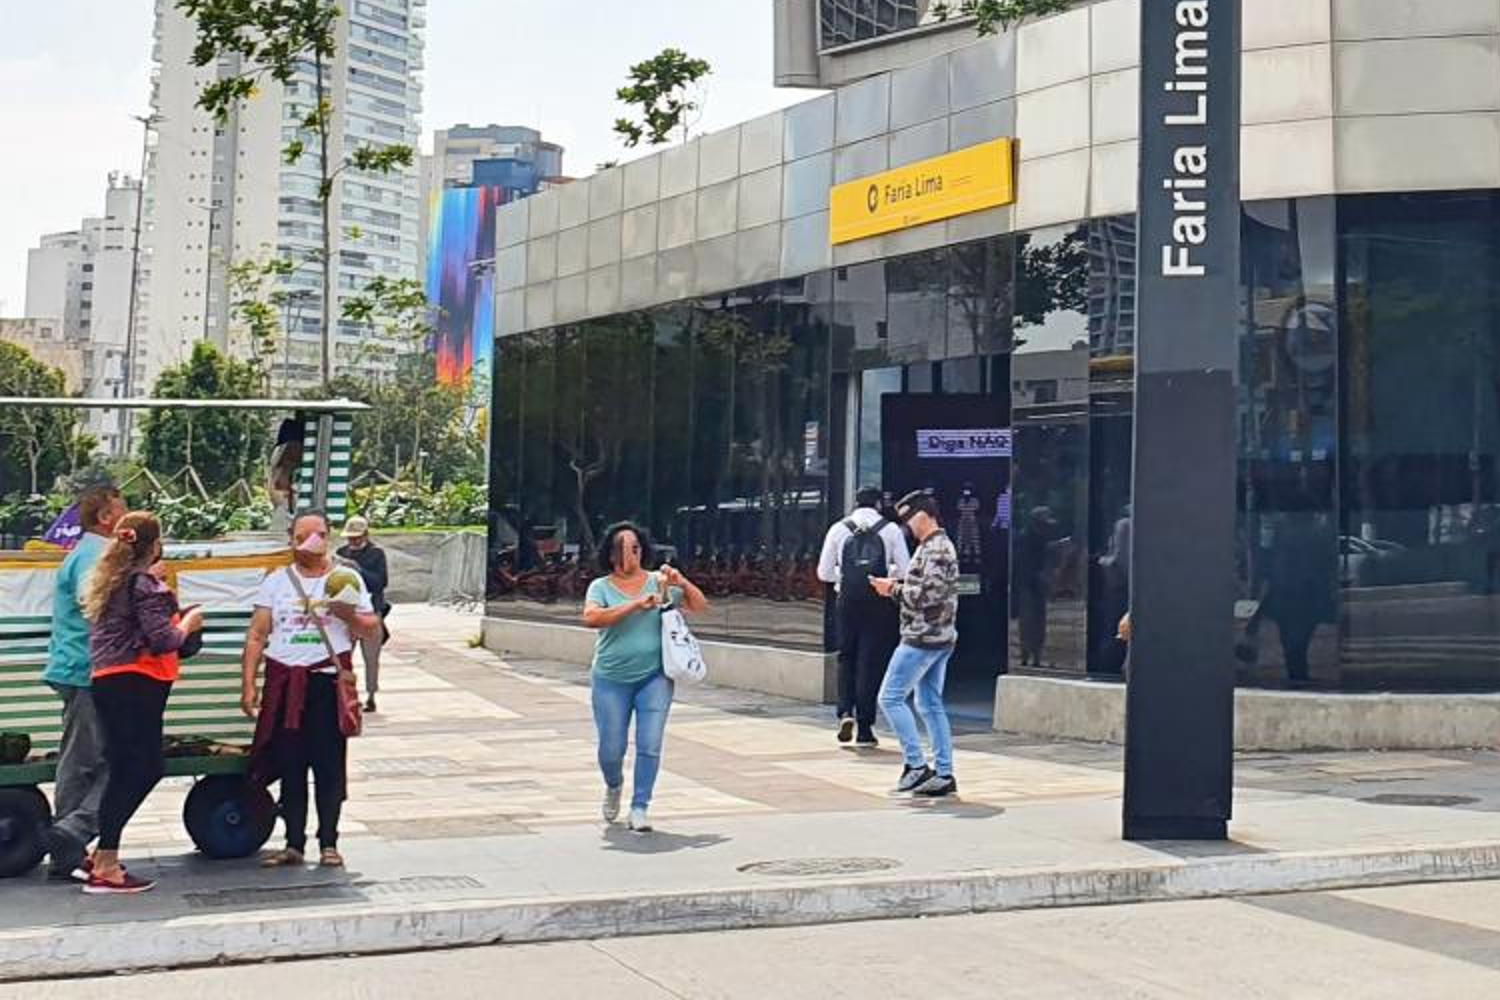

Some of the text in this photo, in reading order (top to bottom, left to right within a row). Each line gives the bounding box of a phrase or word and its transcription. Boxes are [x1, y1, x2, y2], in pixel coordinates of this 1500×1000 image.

[884, 171, 944, 205] Faria Lima
[1162, 145, 1208, 277] Faria
